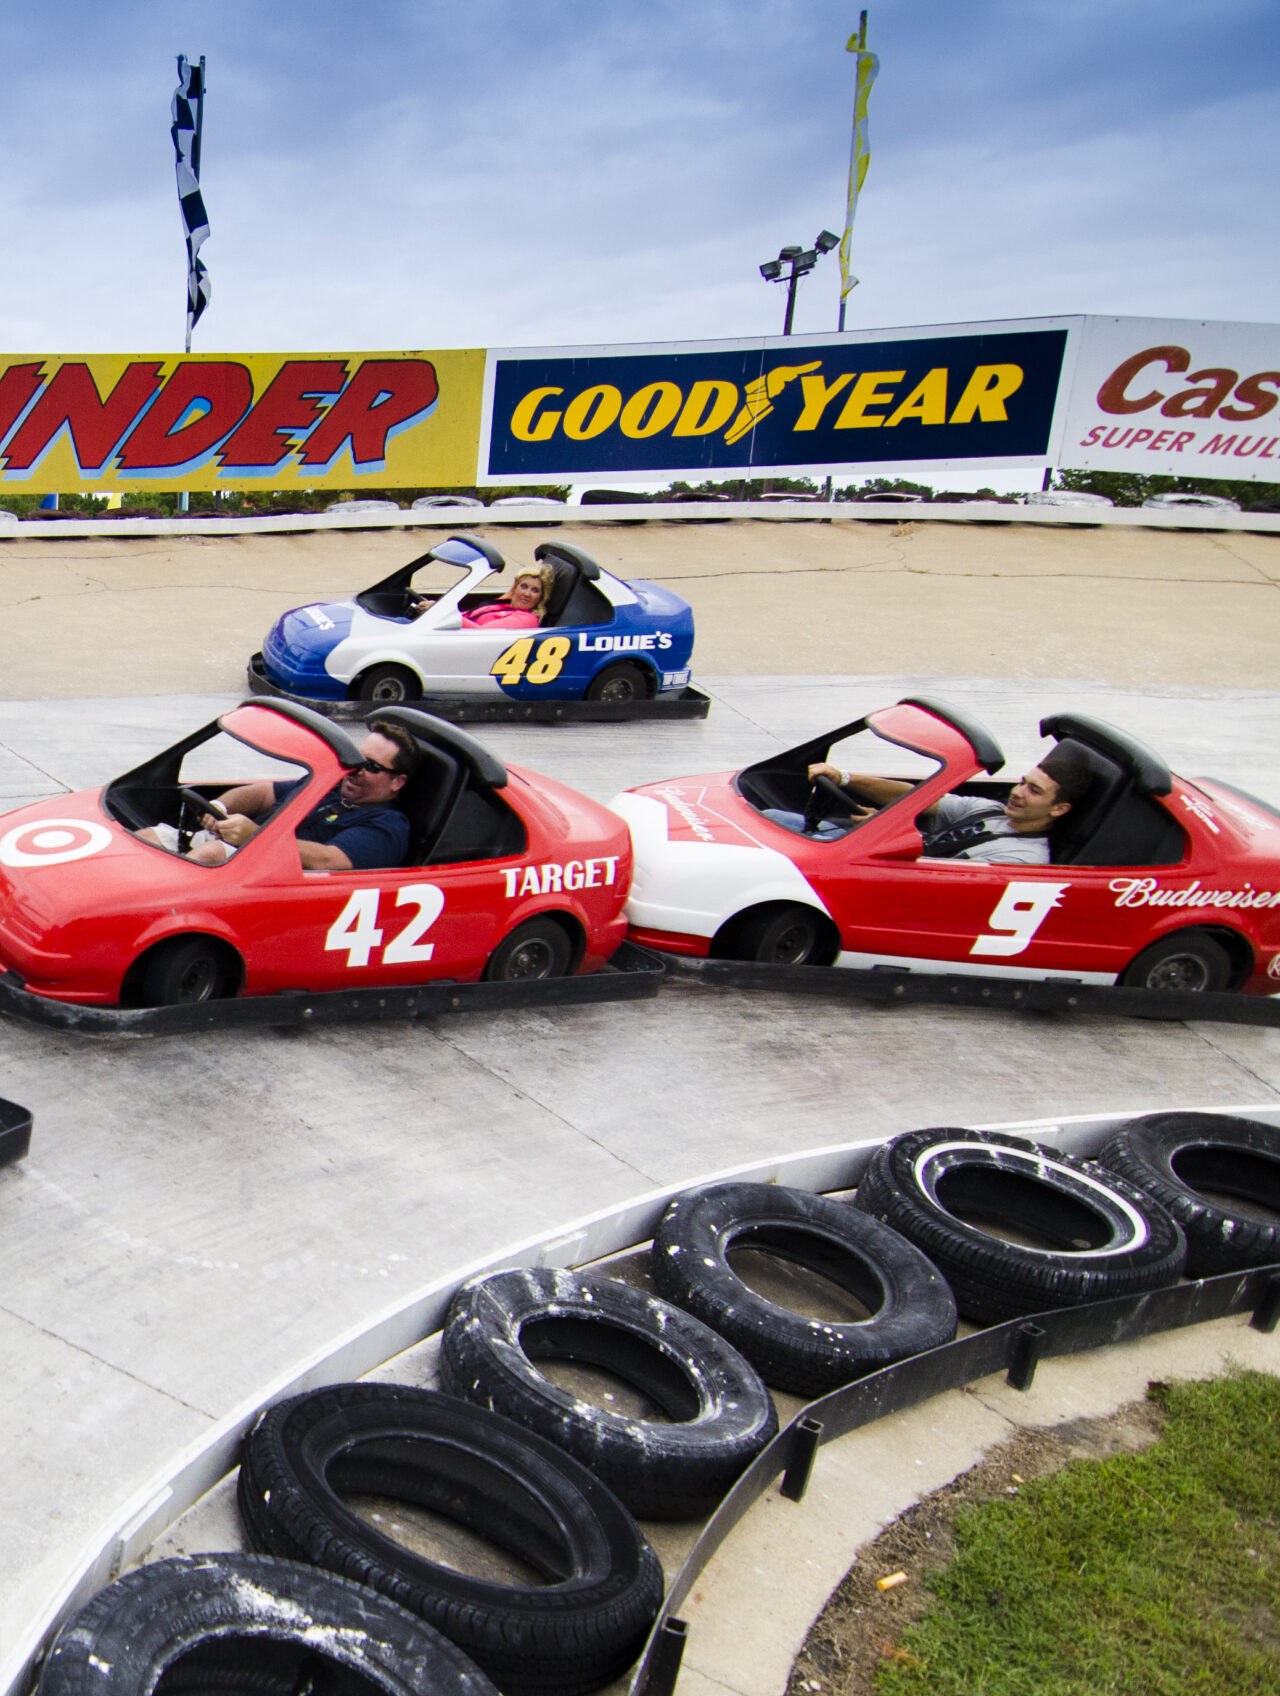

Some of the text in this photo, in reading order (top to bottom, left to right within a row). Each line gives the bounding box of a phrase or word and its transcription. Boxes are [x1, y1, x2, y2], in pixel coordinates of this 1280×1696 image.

[1096, 345, 1280, 421] Cas
[1079, 425, 1280, 459] SUPER MUL
[490, 638, 572, 686] 48
[578, 630, 673, 652] LOWE'S
[500, 856, 619, 898] TARGET
[325, 883, 445, 967] 42
[970, 881, 1071, 956] 9
